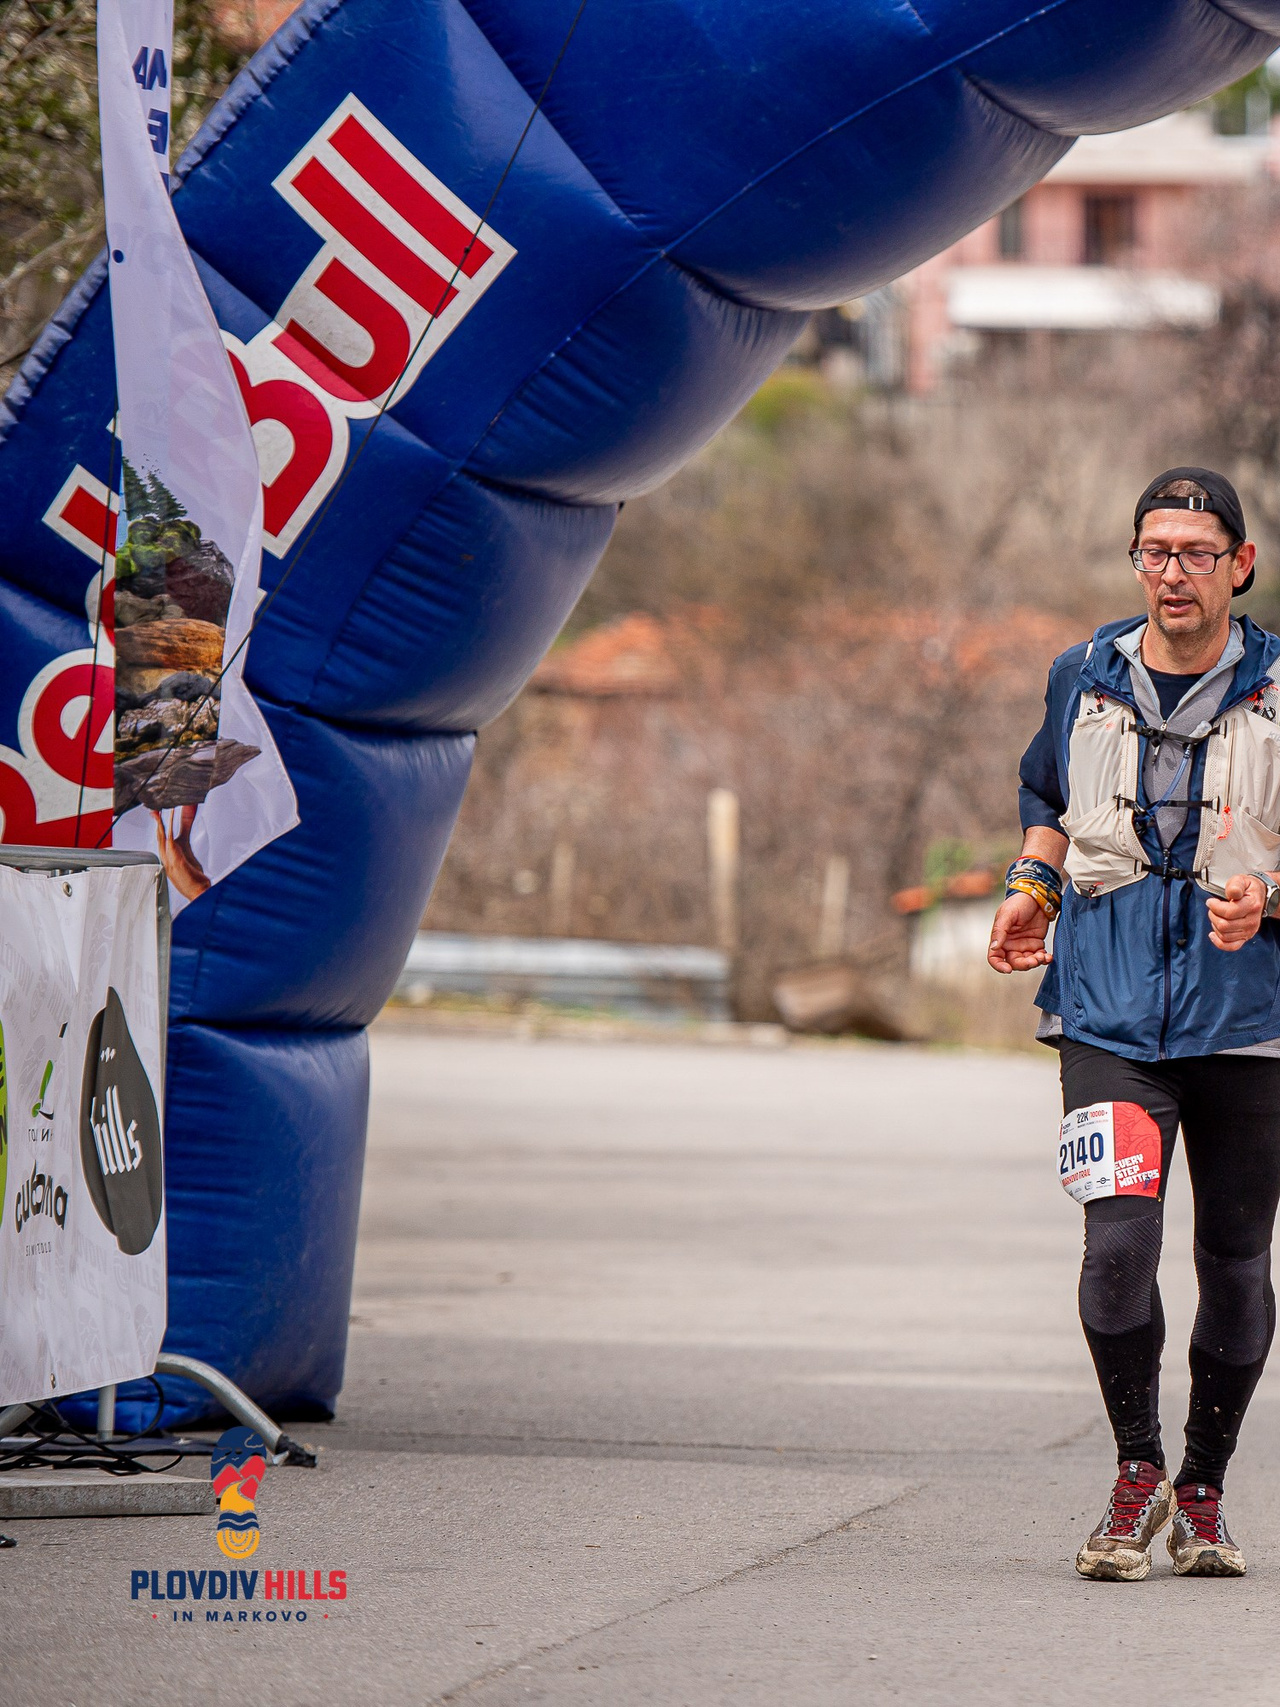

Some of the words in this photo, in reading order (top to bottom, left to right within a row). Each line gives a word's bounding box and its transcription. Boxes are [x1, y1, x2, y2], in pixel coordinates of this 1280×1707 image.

[90, 1084, 143, 1176] hills
[1059, 1132, 1104, 1175] 2140
[1114, 1153, 1144, 1170] EVERY
[1115, 1165, 1141, 1180] STEP
[1118, 1168, 1160, 1189] MATTERS
